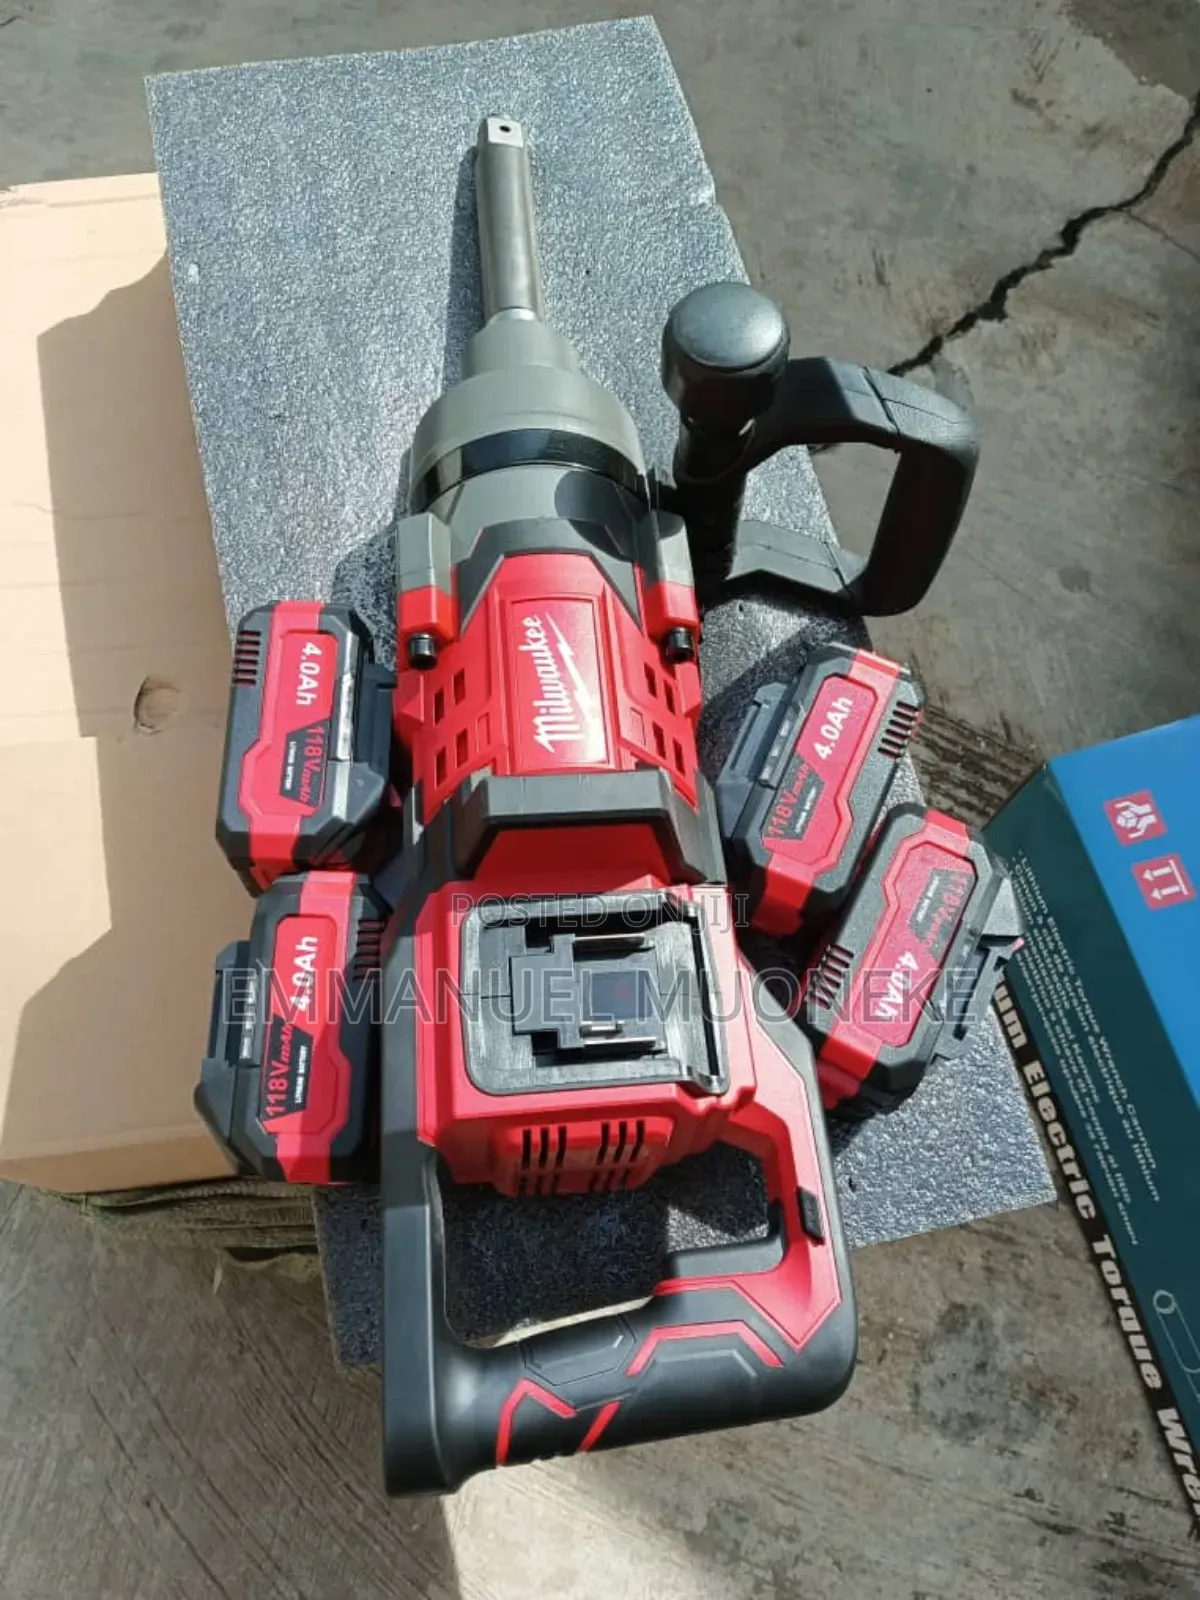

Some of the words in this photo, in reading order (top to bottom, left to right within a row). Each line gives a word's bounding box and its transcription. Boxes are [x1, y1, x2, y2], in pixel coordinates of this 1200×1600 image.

[296, 642, 322, 706] 4.0Ah
[518, 615, 586, 753] Milwaukee
[813, 697, 853, 760] 4.0Ah
[290, 936, 318, 1013] 4.0Ah
[875, 951, 919, 1018] 4.0Ah
[1046, 916, 1077, 975] Electric
[1072, 977, 1100, 1033] Torque
[1097, 1035, 1129, 1099] Wrench
[1023, 1061, 1096, 1219] Electric
[1091, 1234, 1162, 1389] Torque
